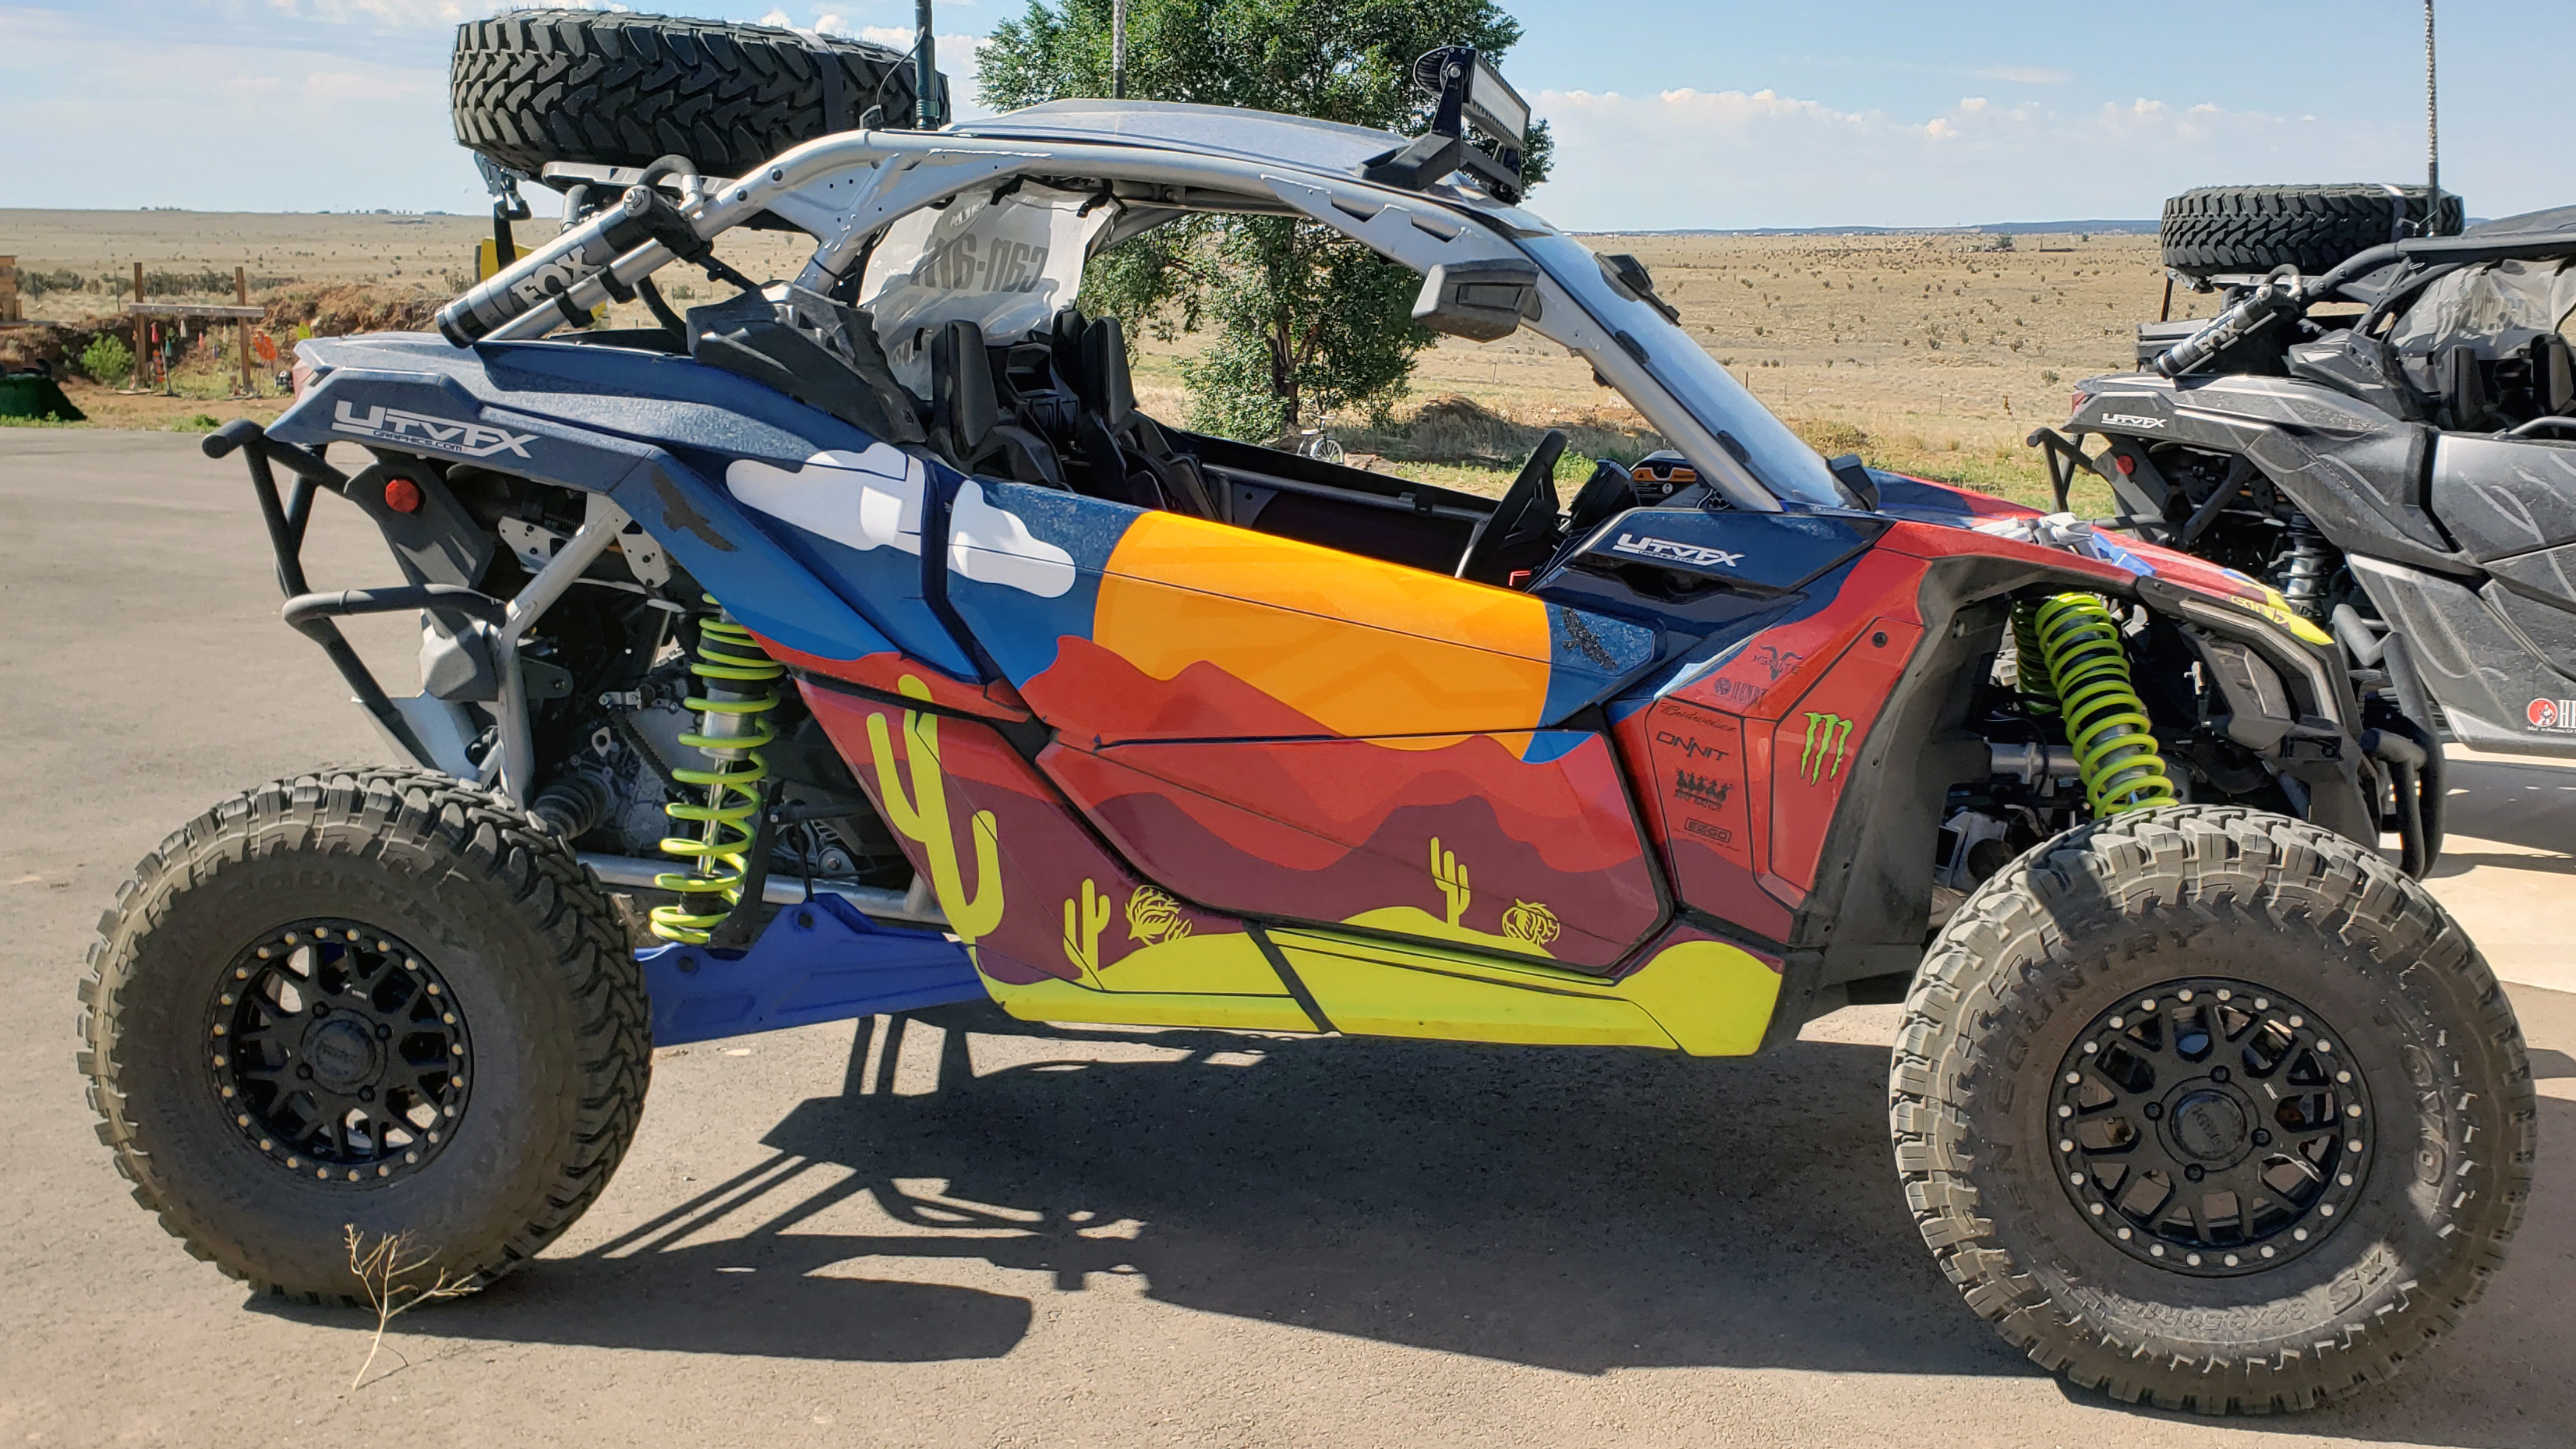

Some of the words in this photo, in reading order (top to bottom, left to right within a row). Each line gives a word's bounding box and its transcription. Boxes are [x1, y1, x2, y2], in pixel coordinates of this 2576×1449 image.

[511, 245, 602, 309] FOX
[2193, 318, 2245, 355] FOX
[1655, 730, 1730, 762] ONNIT
